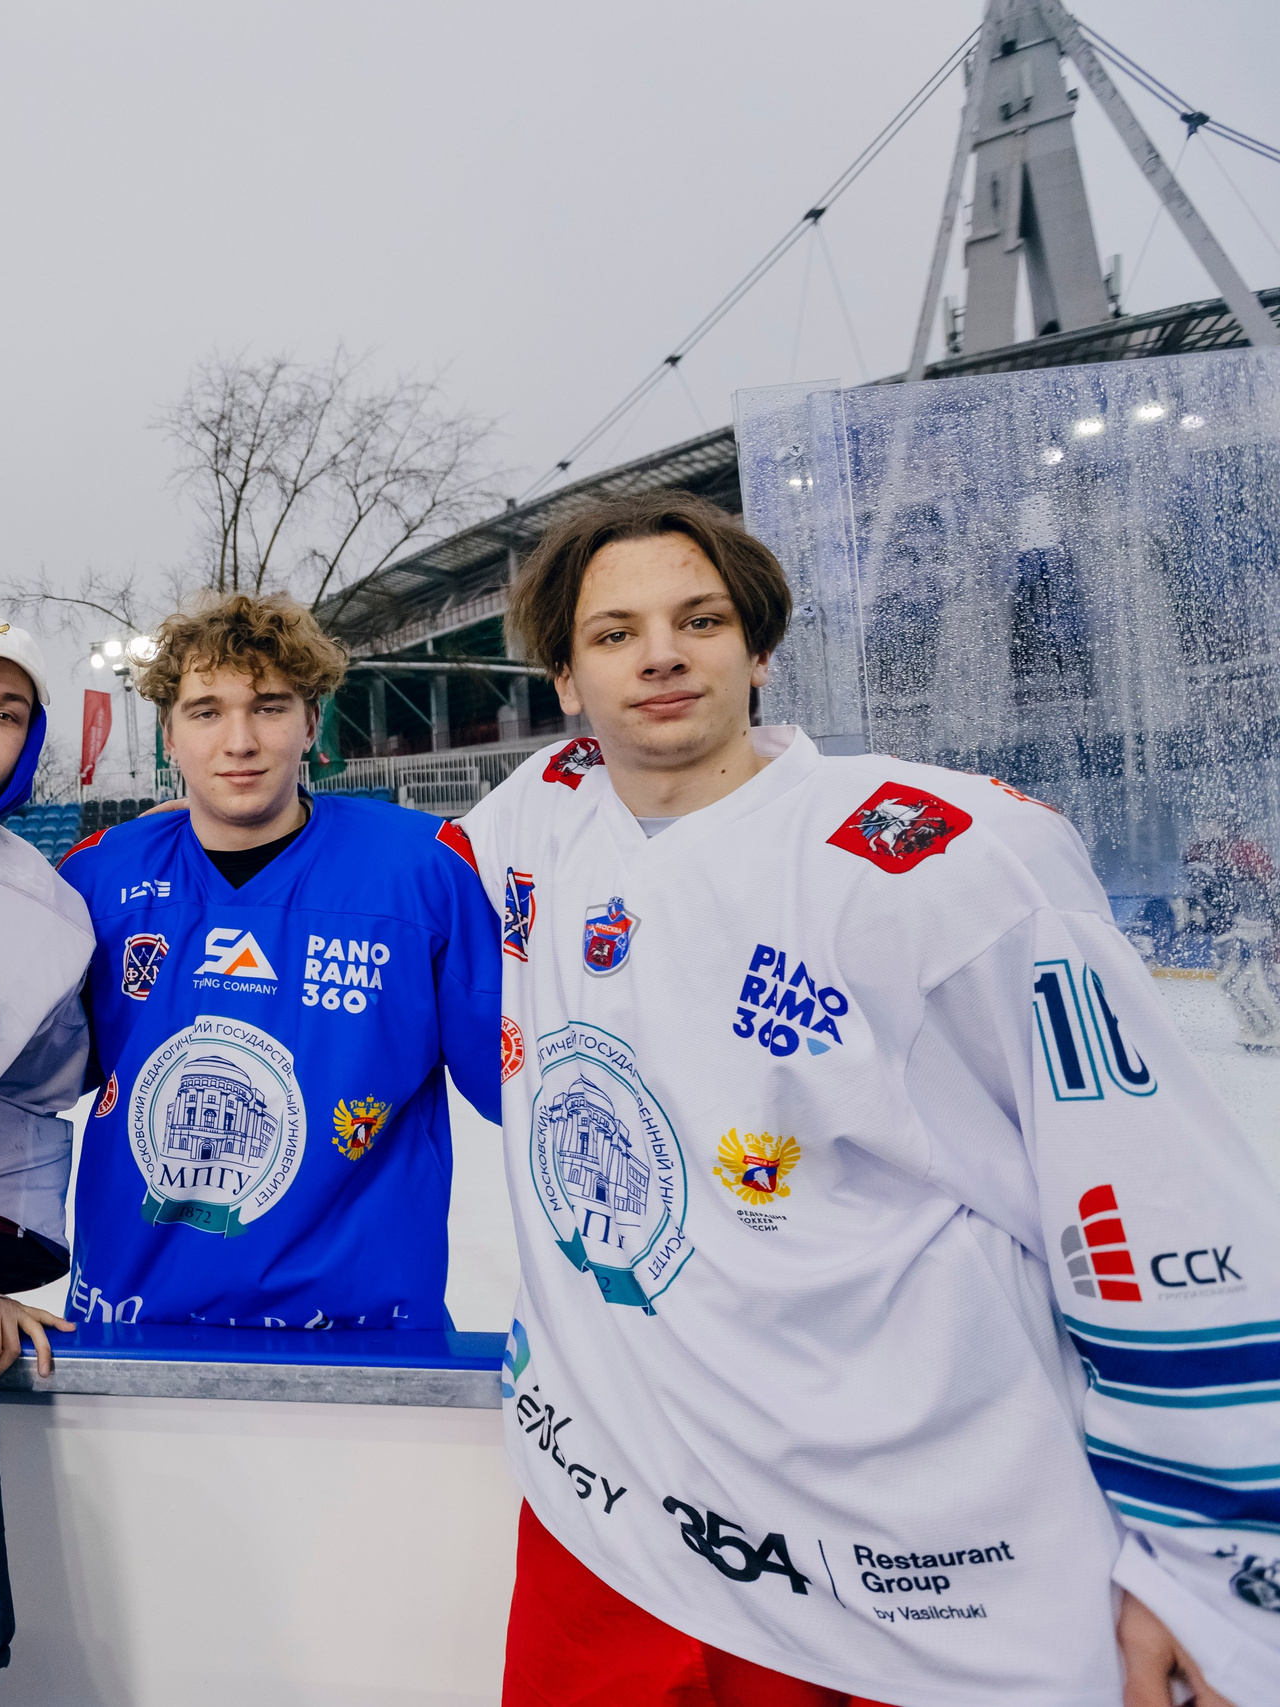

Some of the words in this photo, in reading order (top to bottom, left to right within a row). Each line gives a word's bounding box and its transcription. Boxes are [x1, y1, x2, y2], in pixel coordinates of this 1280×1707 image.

[595, 921, 623, 935] МОСКВА
[307, 934, 391, 966] PANO
[222, 980, 278, 996] COMPANY
[304, 957, 383, 991] RAMA
[748, 943, 849, 1017] PANO
[301, 982, 368, 1015] 360
[739, 973, 844, 1046] RAMA
[732, 1005, 800, 1057] 360
[133, 1094, 155, 1177] ОСКОВСКИЙ
[254, 1119, 300, 1209] УНИВЕРСИТЕТ
[157, 1163, 252, 1196] МПГУ
[178, 1205, 212, 1224] 1872
[662, 1495, 813, 1596] 354
[853, 1540, 1015, 1570] Restaurant
[861, 1571, 951, 1595] Group
[873, 1607, 895, 1623] by
[897, 1603, 988, 1621] Vasilchuki
